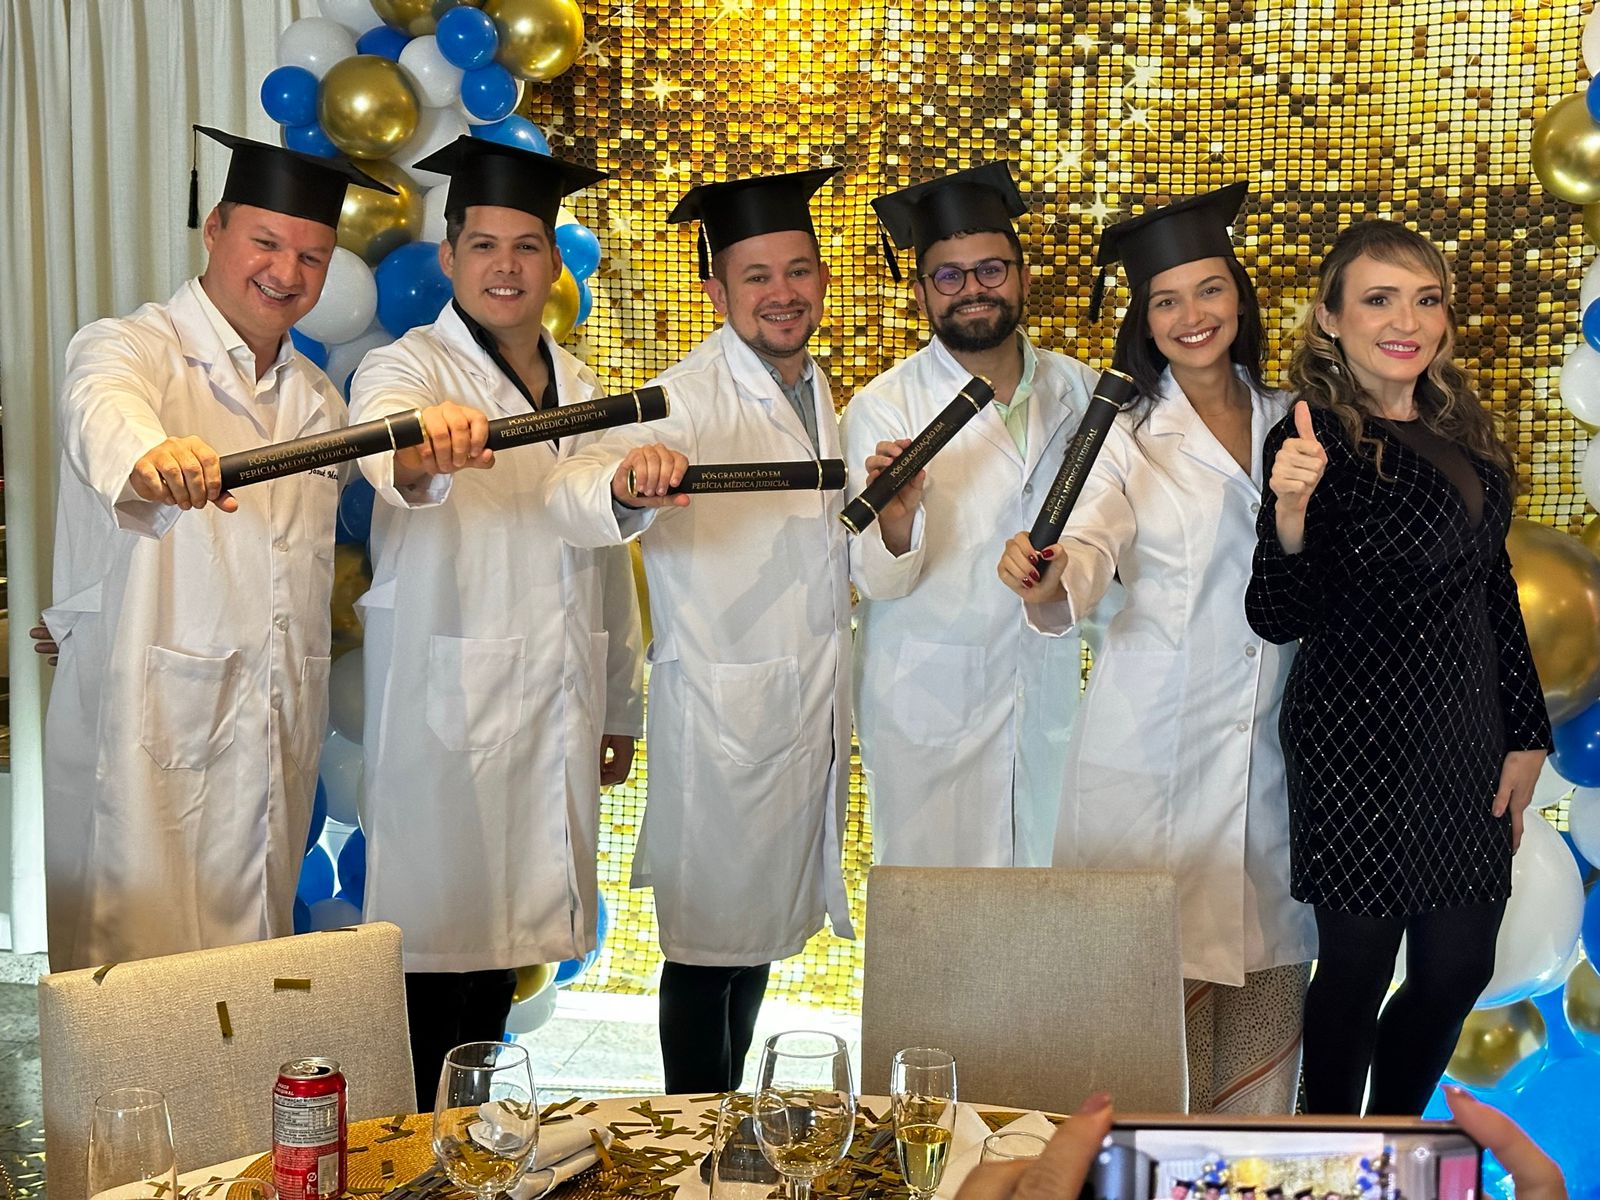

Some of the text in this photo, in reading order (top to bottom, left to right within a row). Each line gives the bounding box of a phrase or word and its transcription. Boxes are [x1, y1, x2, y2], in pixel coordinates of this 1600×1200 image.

[500, 423, 535, 438] PERÍCIA
[535, 417, 570, 431] MÉDICA
[570, 409, 608, 425] JUDICIAL
[508, 403, 596, 426] PÓS GRADUAÇÃO EM
[248, 436, 347, 467] PÓS GRADUAÇÃO EM
[317, 445, 360, 463] JUDICIAL
[889, 421, 946, 478] PÓS GRADUAÇÃO EM
[692, 480, 791, 490] PERÍCIA MÉDICA JUDICIAL
[701, 471, 717, 480] PÓS
[718, 470, 768, 480] GRADUAÇÃO
[1049, 428, 1099, 525] PERÍCIA MÉDICA JUDICIAL
